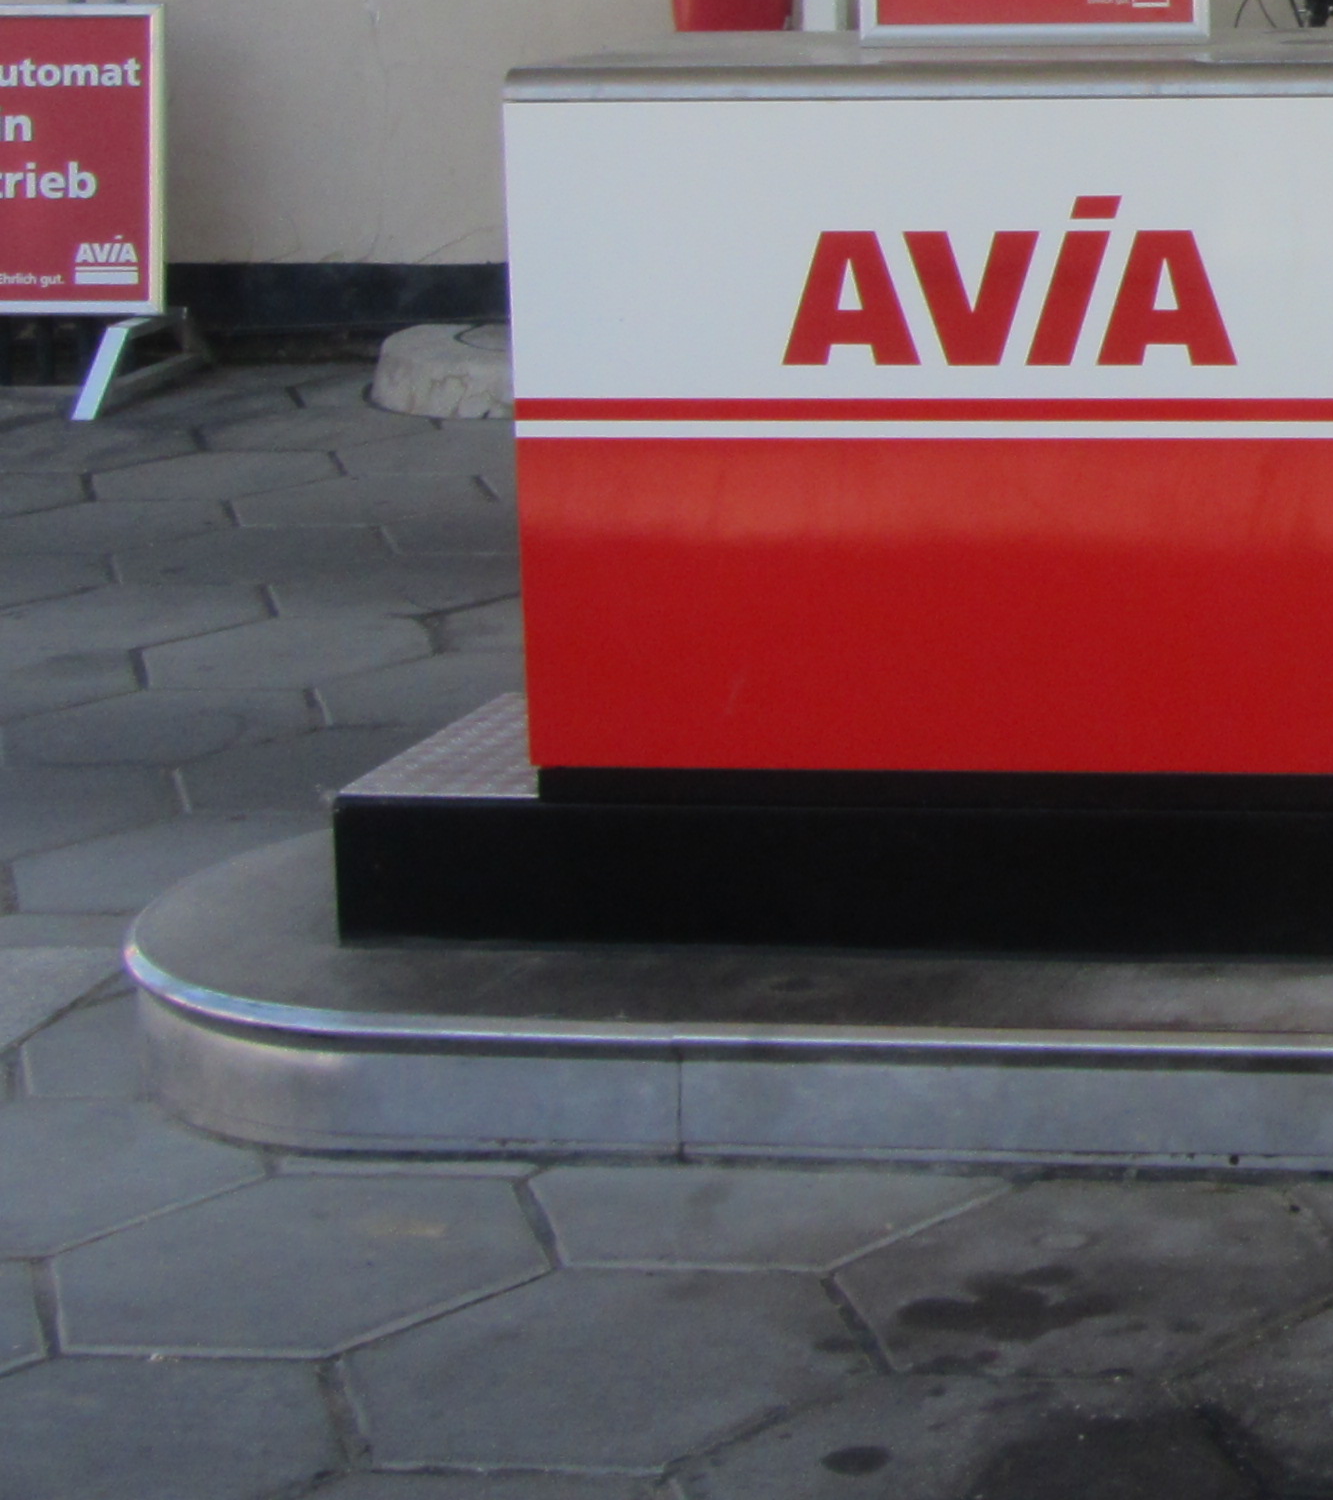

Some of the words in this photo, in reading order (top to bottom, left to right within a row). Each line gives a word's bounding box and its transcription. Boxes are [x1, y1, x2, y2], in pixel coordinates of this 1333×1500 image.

[75, 235, 137, 263] AVIA
[40, 274, 65, 287] gut.
[782, 195, 1237, 367] AVIA
